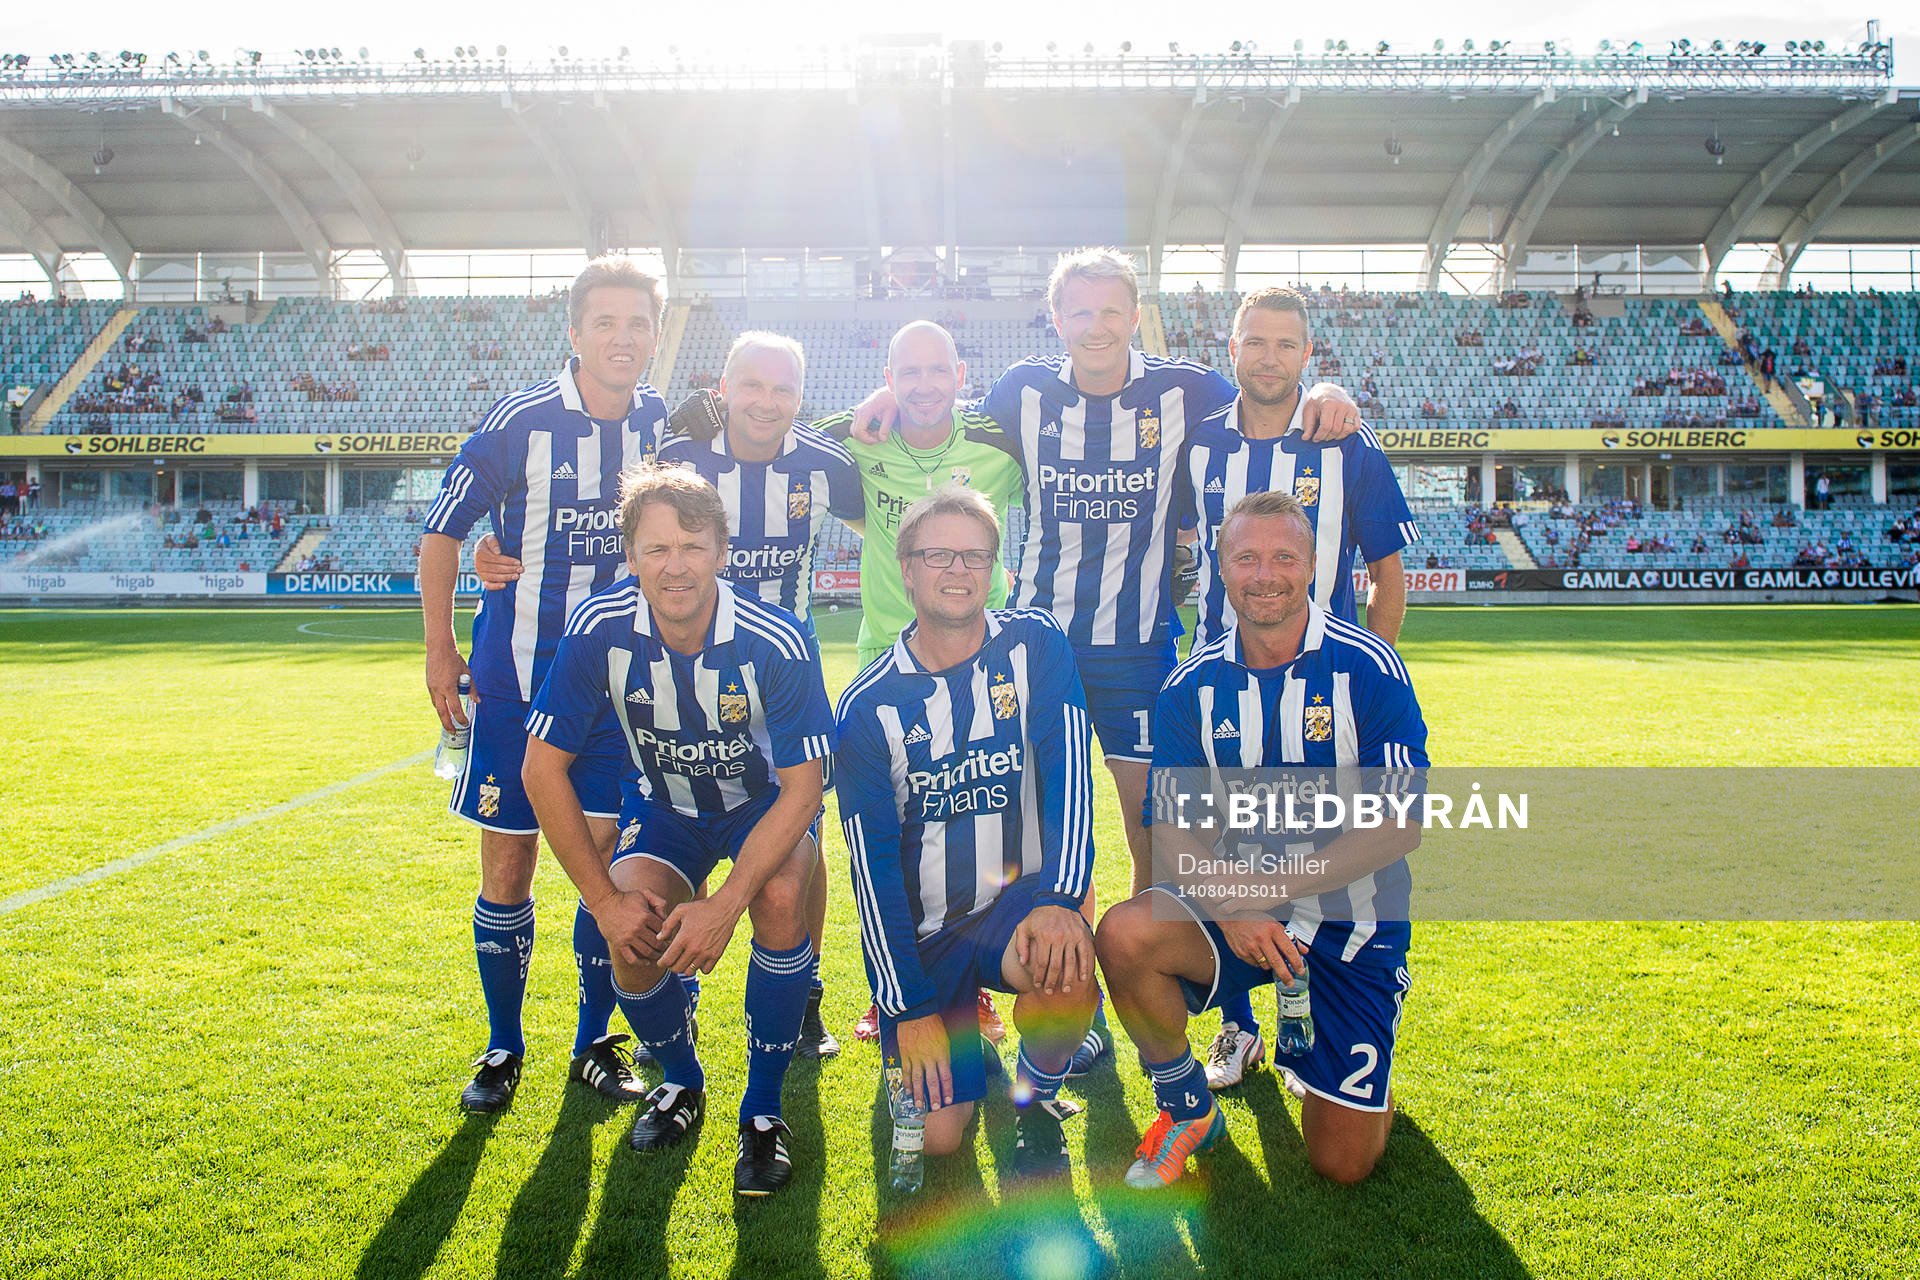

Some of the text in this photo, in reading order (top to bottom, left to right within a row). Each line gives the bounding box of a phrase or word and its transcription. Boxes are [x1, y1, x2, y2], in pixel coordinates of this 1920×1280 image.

[88, 437, 205, 453] SOHLBERG
[338, 435, 458, 452] SOHLBERG
[1626, 431, 1746, 447] SOHLBERG
[551, 472, 578, 480] adidas
[1040, 464, 1156, 493] Prioritet
[1053, 492, 1138, 519] Finans
[285, 574, 391, 592] DEMIDEKK
[1562, 571, 1735, 589] GAMLA ULLEVI
[1744, 571, 1914, 588] GAMLA ULLEVI
[904, 733, 932, 745] adidas
[1213, 730, 1240, 740] adidas
[636, 727, 754, 761] Prioritet
[655, 751, 746, 777] Finans
[1339, 1043, 1378, 1099] 2
